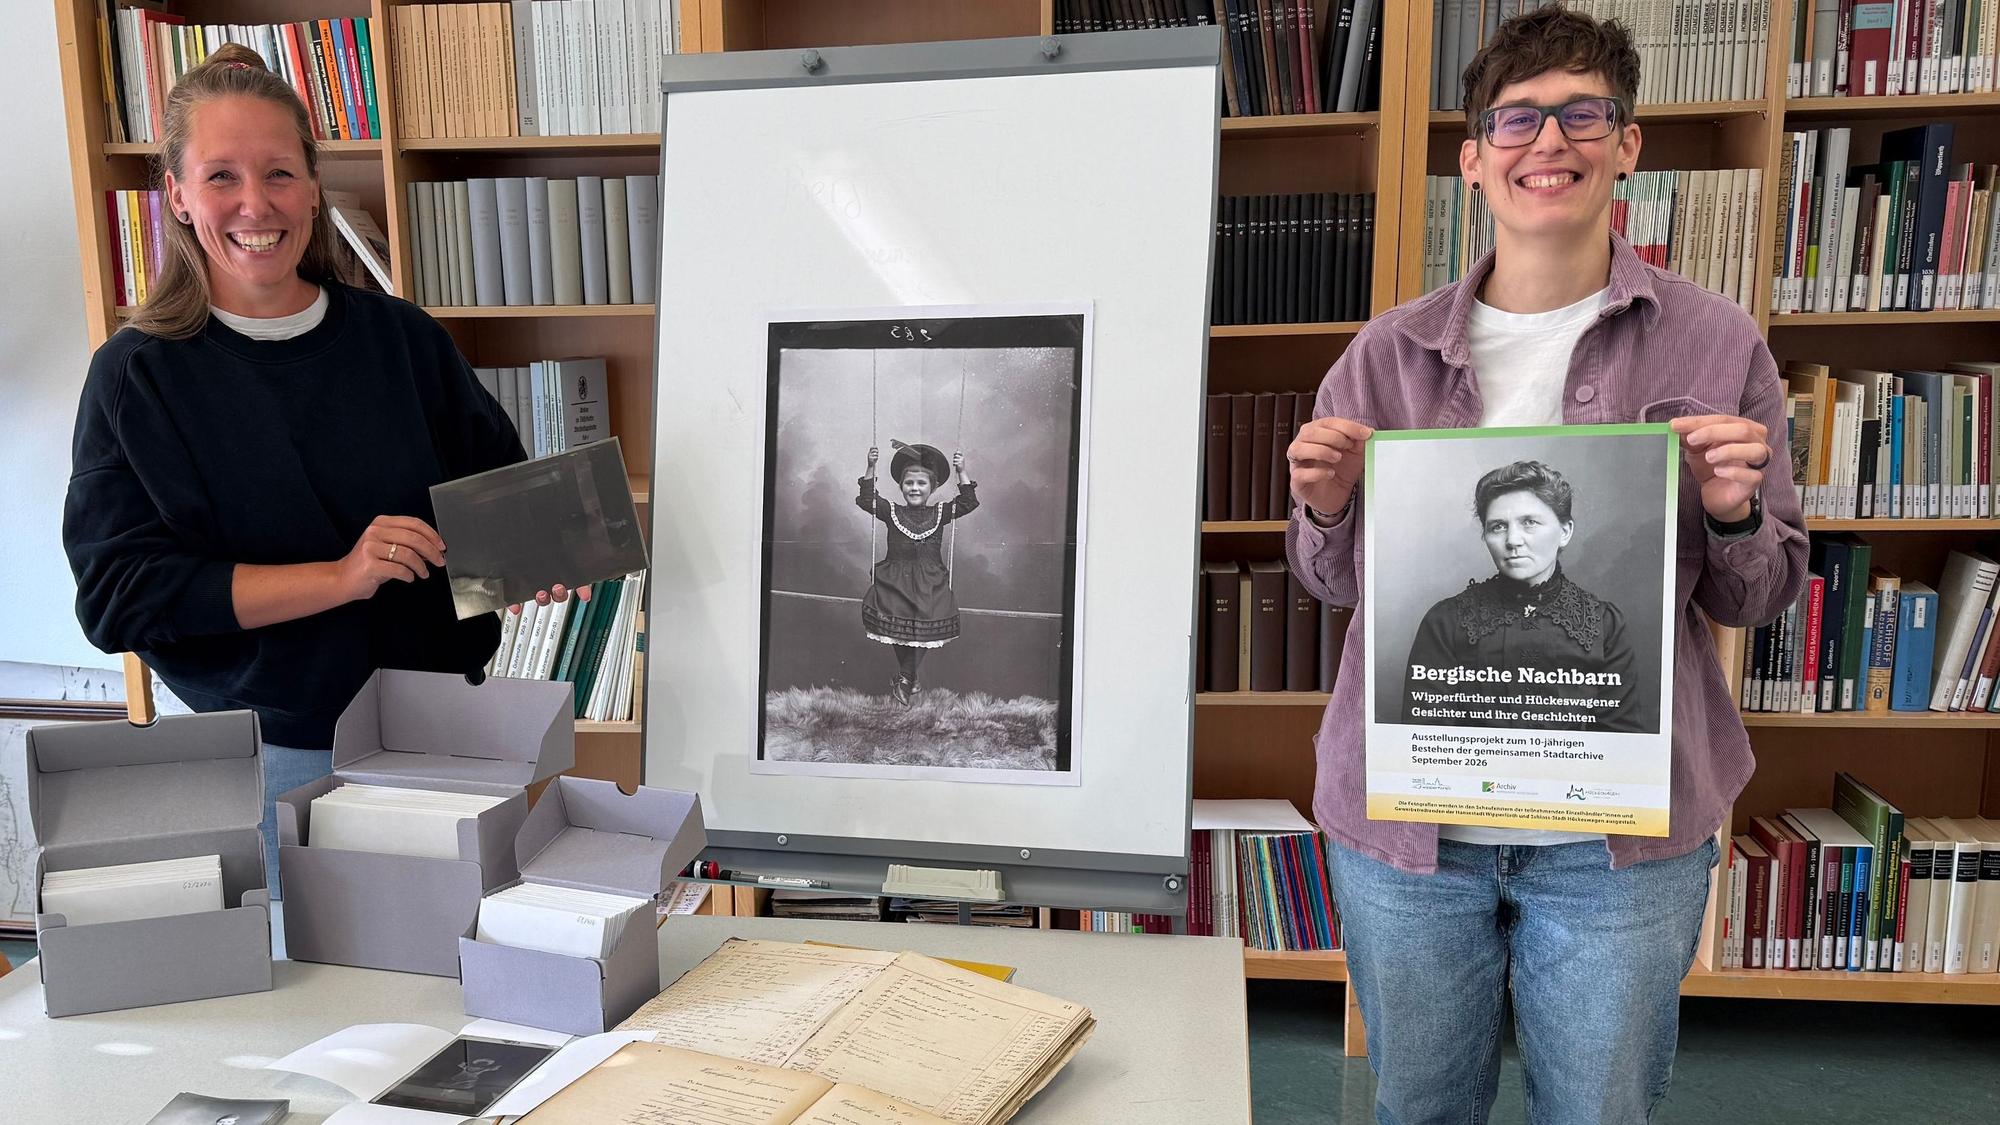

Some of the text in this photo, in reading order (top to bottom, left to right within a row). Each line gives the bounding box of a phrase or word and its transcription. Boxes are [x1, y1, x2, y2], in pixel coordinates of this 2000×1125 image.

[1727, 2, 1735, 33] ROMERIKE
[326, 42, 334, 63] Kalender
[1675, 207, 1683, 235] Heimatpflege
[1719, 205, 1727, 234] Heimatpflege
[1774, 177, 1790, 253] BERGISCHE
[1826, 233, 1836, 269] Wipperfürth
[1885, 409, 1893, 429] Wupper
[1831, 563, 1840, 592] Wipperfürth
[1812, 584, 1820, 618] RHEINLAND
[1811, 618, 1817, 626] IM
[1809, 626, 1817, 645] BAUEN
[1882, 608, 1896, 663] KIRCHHOFF
[1826, 639, 1835, 669] Quellenbuch
[1411, 664, 1622, 686] Bergische Nachbarn
[1411, 691, 1621, 709] Wipperfürther und Hückeswagener
[1411, 707, 1597, 723] Gesichter und ihre Geschichten
[1411, 733, 1504, 746] Ausstellungsprojekt
[1529, 737, 1585, 749] 10-jährigen
[1411, 744, 1604, 761] Bestehen der gemeinsamen Stadtarchive
[1411, 756, 1488, 768] September 2026
[1496, 782, 1517, 791] Archiv
